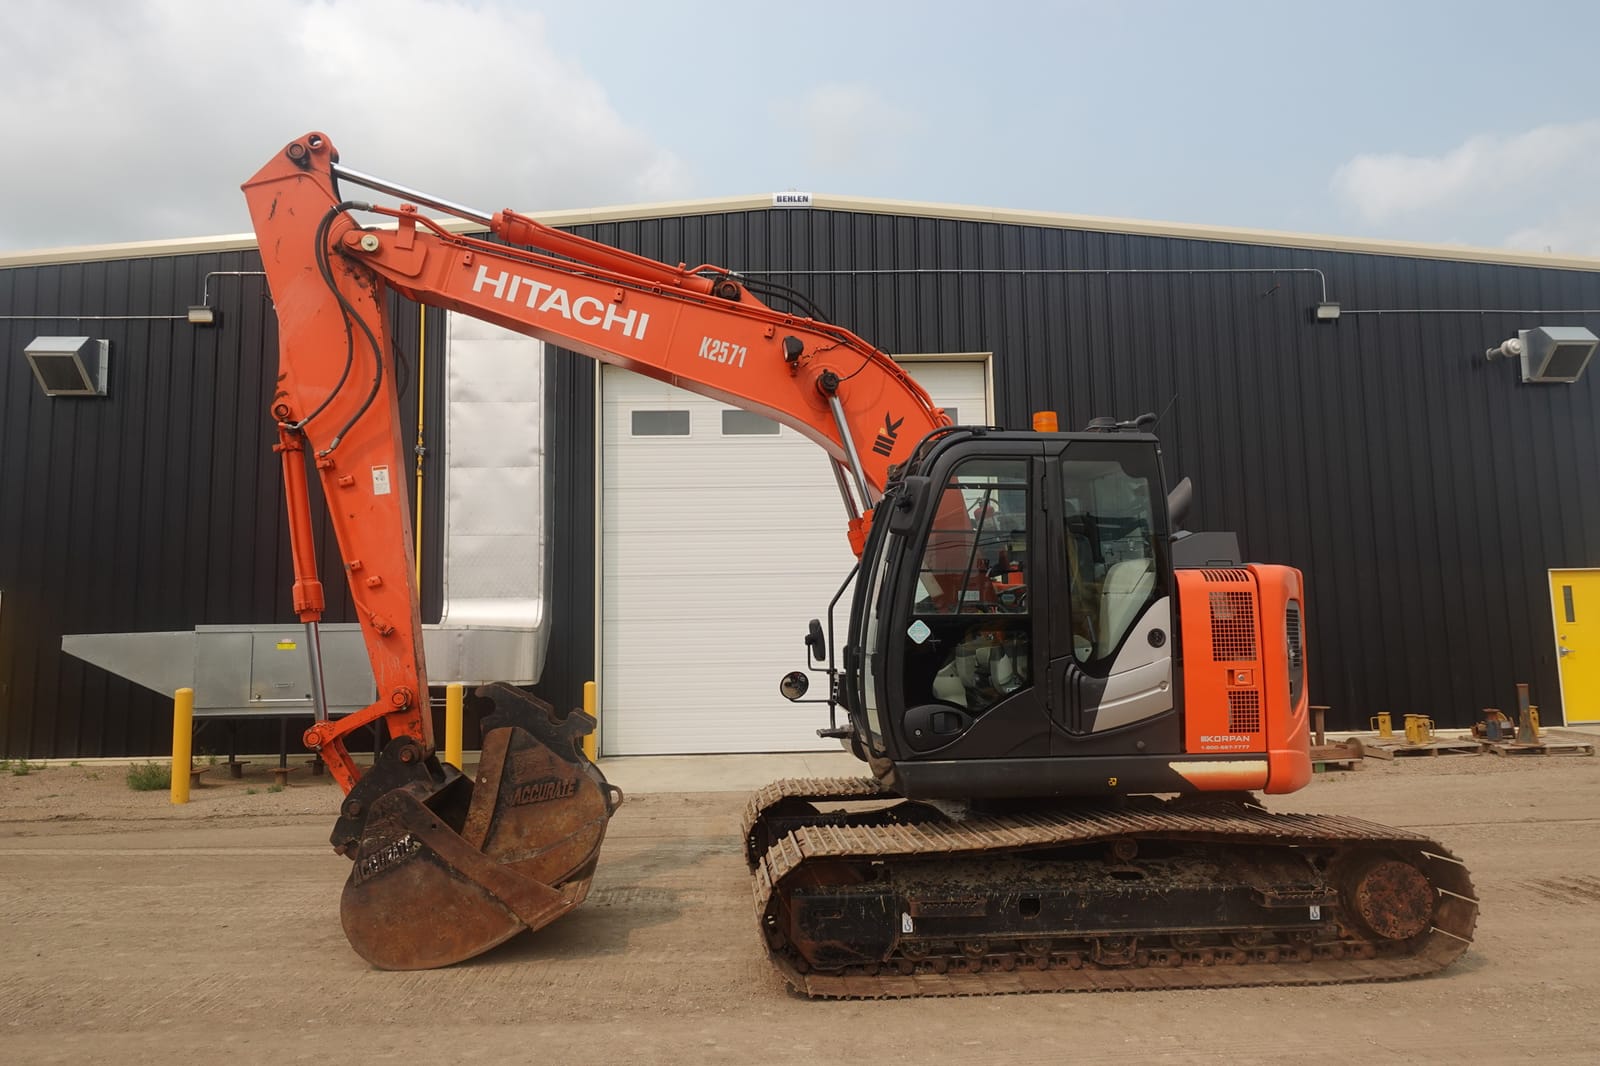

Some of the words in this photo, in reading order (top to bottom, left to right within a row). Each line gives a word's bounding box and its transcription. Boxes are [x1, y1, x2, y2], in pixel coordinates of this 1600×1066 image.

[776, 195, 809, 203] BEHLEN
[472, 265, 650, 341] HITACHI
[698, 336, 747, 368] K2571
[511, 779, 577, 807] ACCURATE
